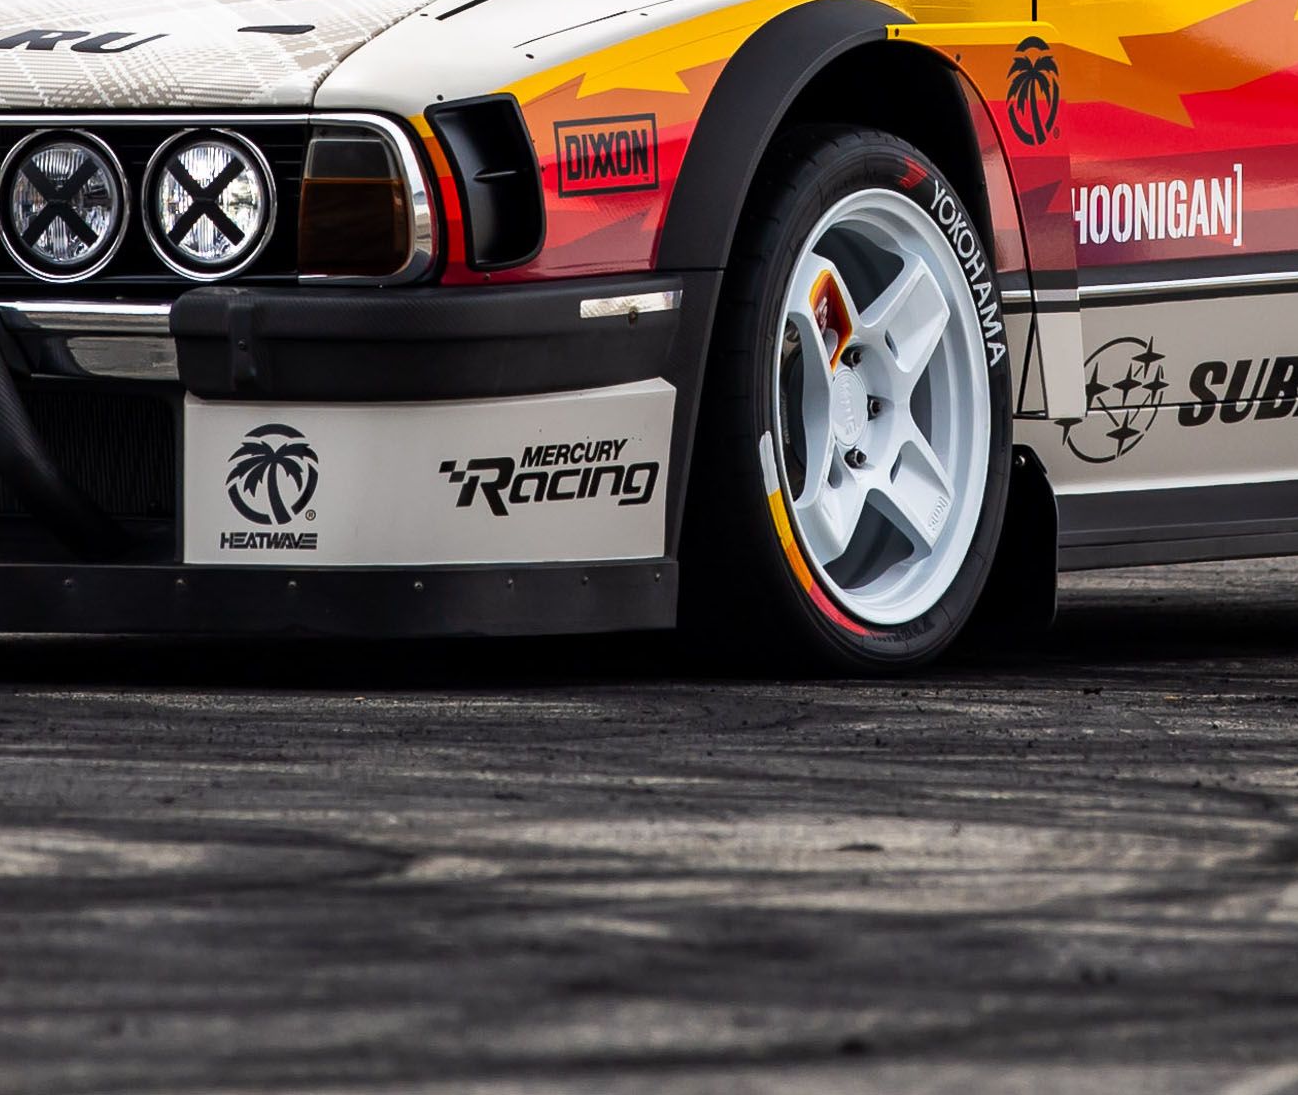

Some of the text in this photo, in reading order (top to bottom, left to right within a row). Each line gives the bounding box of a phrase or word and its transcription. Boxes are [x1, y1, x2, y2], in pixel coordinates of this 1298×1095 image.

[564, 128, 650, 181] DIXXON
[932, 178, 1007, 369] YOKOHAMA
[519, 438, 629, 469] MERCURY
[455, 455, 661, 517] Racing
[219, 531, 319, 551] HEATWAVE
